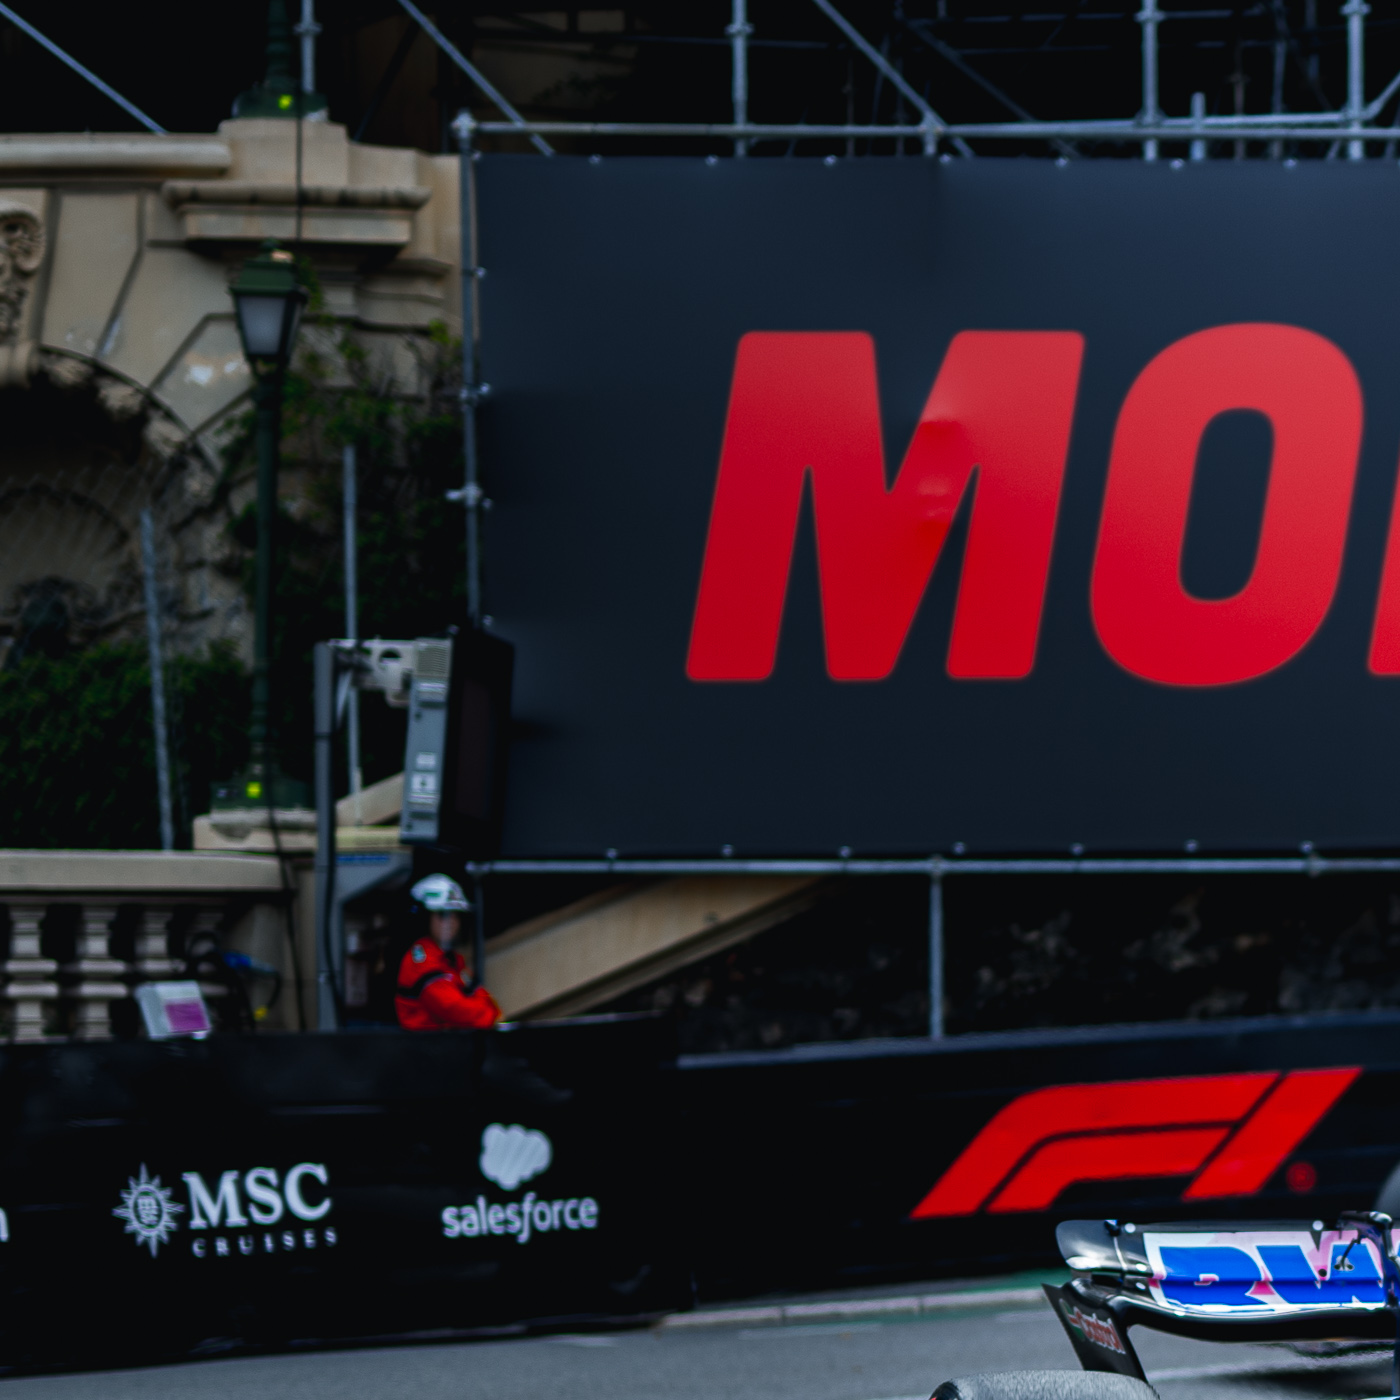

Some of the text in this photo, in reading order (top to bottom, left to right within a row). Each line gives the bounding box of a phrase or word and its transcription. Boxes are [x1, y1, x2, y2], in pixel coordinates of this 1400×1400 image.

[182, 1162, 332, 1229] MSC
[441, 1192, 599, 1244] salesforce
[192, 1227, 338, 1258] CRUISES
